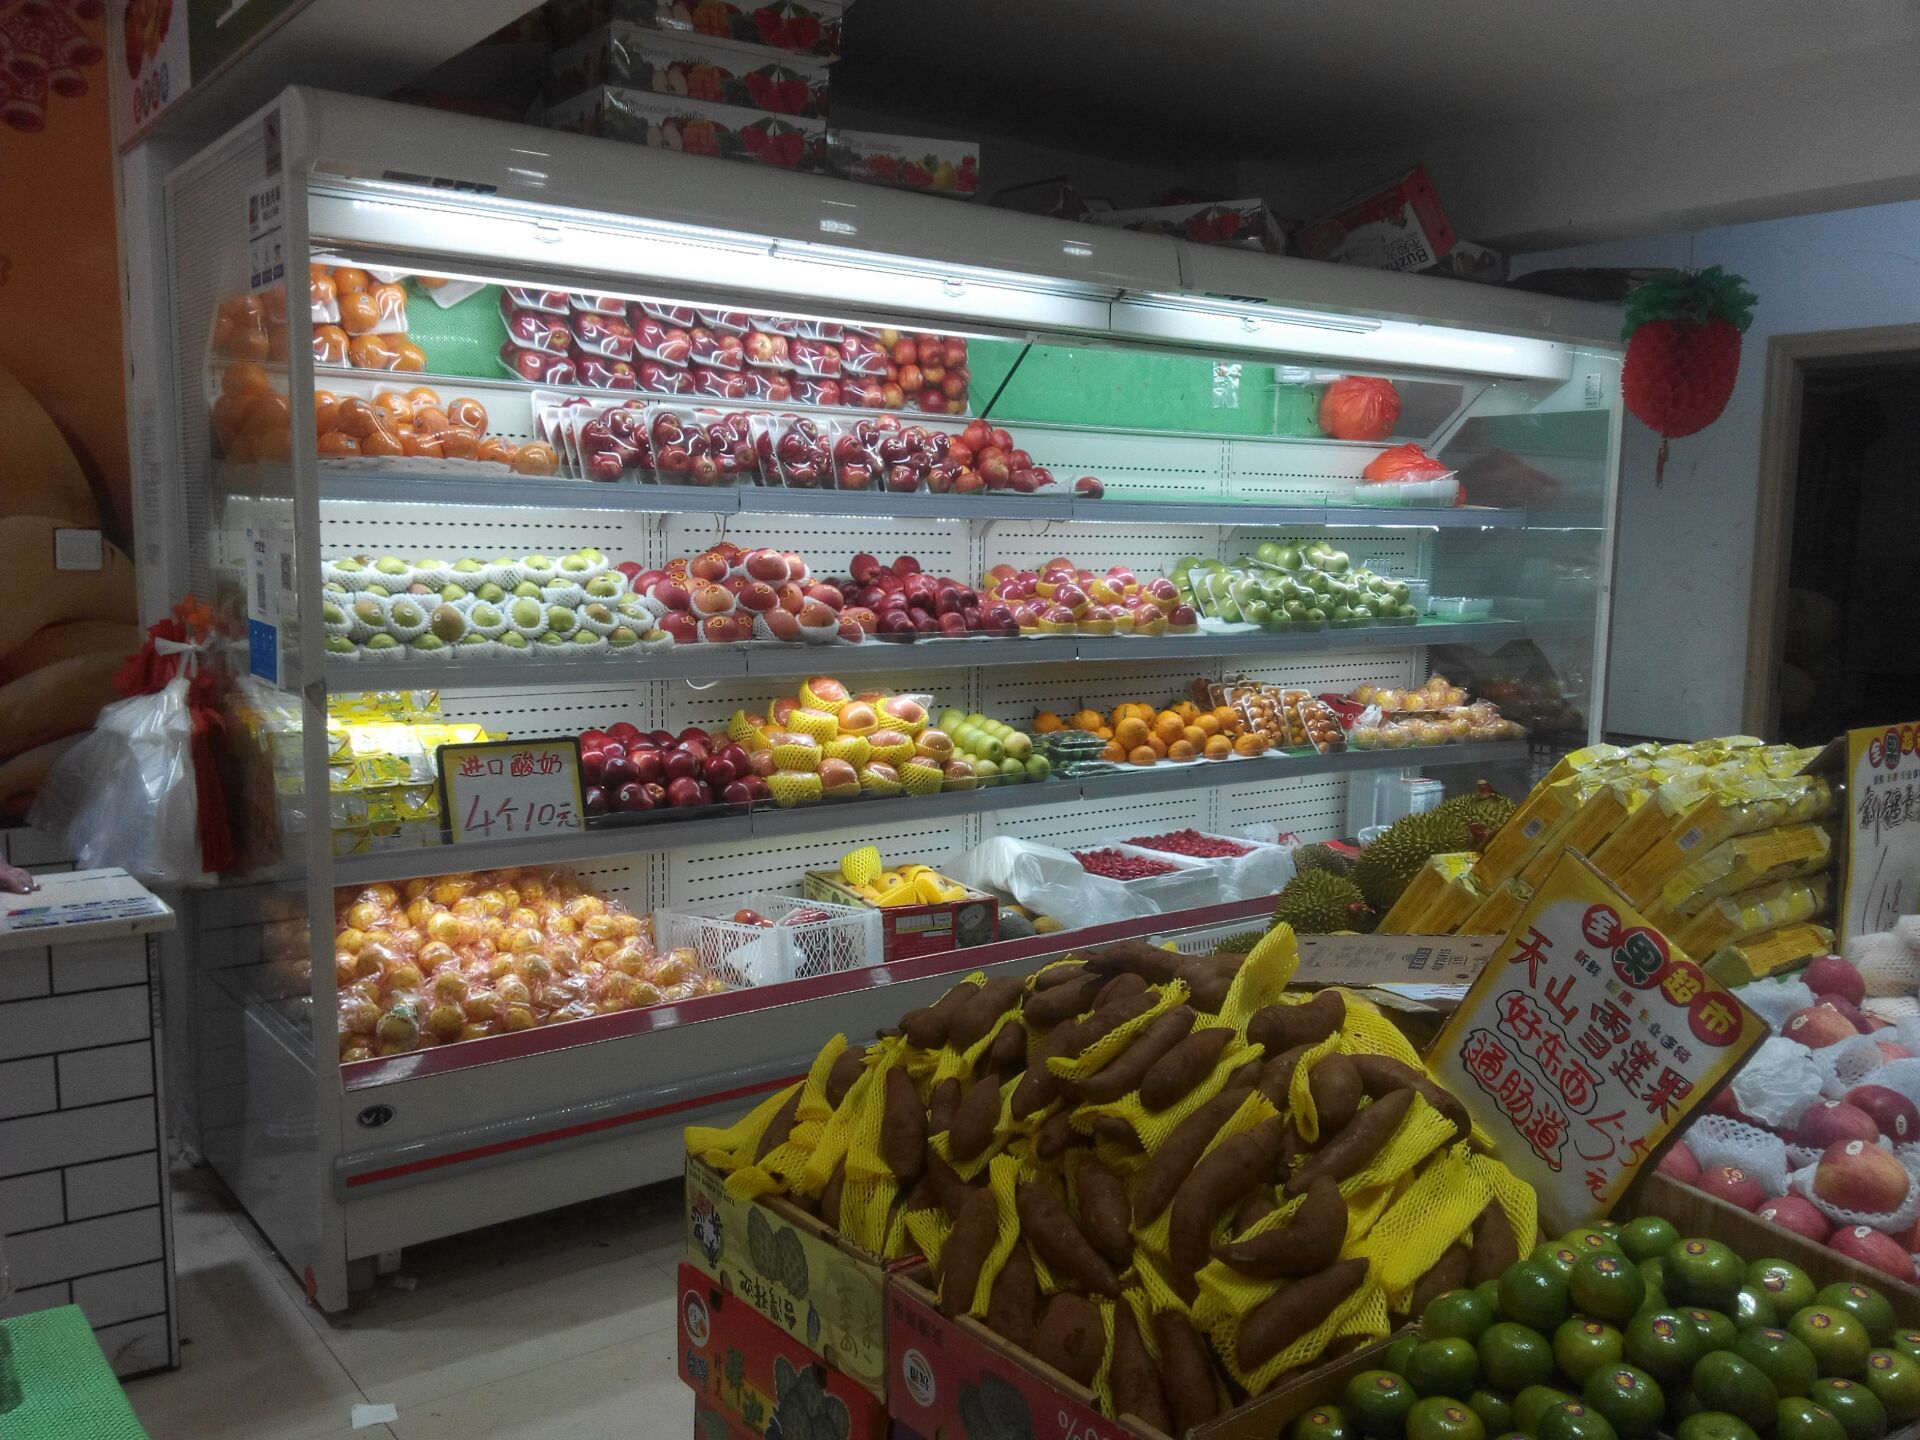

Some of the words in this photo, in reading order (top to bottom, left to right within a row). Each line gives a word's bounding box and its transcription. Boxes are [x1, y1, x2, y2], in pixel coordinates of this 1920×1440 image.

[458, 751, 562, 778] 进口酸奶
[1504, 995, 1596, 1106] 好东西
